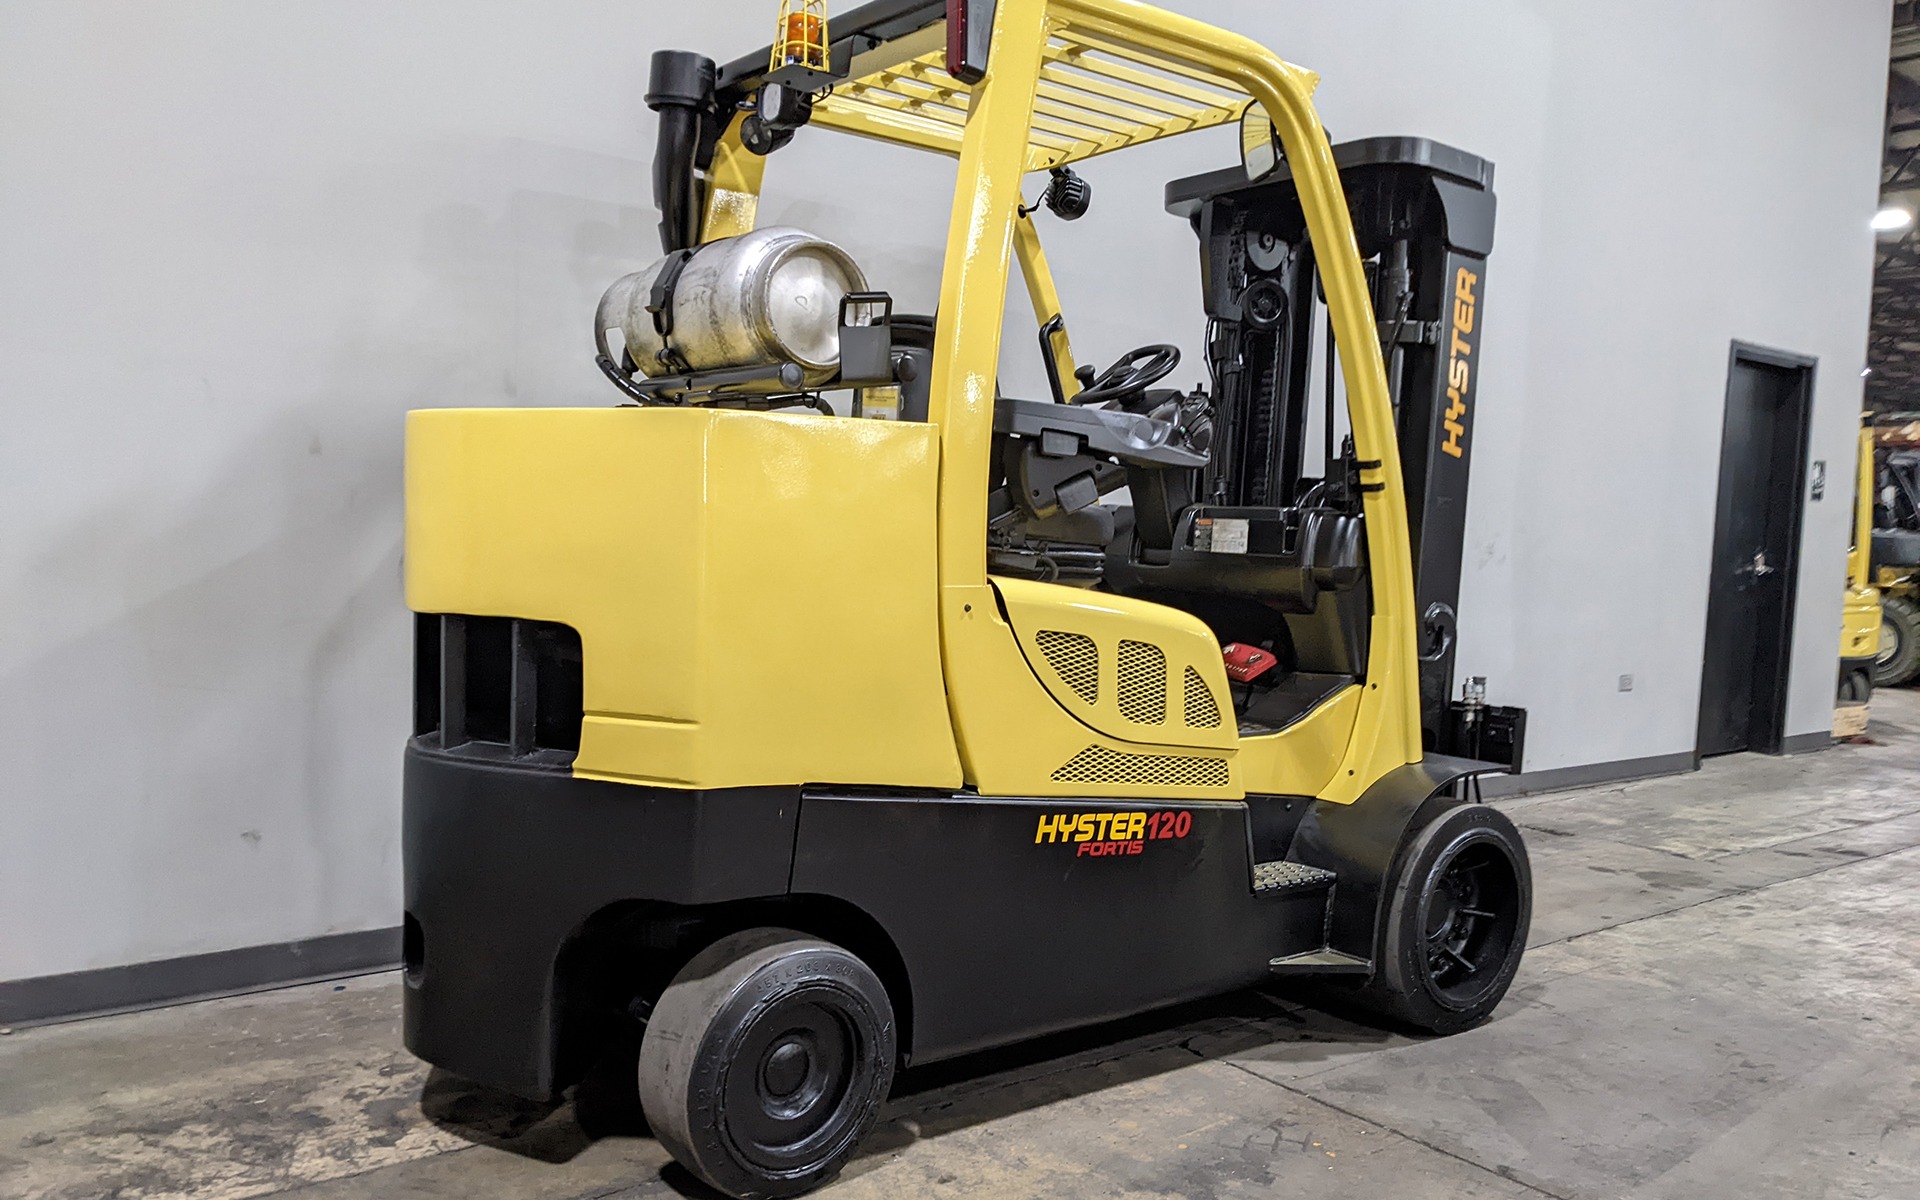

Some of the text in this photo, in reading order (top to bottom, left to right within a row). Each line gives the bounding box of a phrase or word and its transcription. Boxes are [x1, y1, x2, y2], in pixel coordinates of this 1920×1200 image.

[1441, 266, 1478, 459] HYSTER
[1034, 810, 1193, 844] HYSTER 120
[1076, 840, 1144, 857] FORTIS
